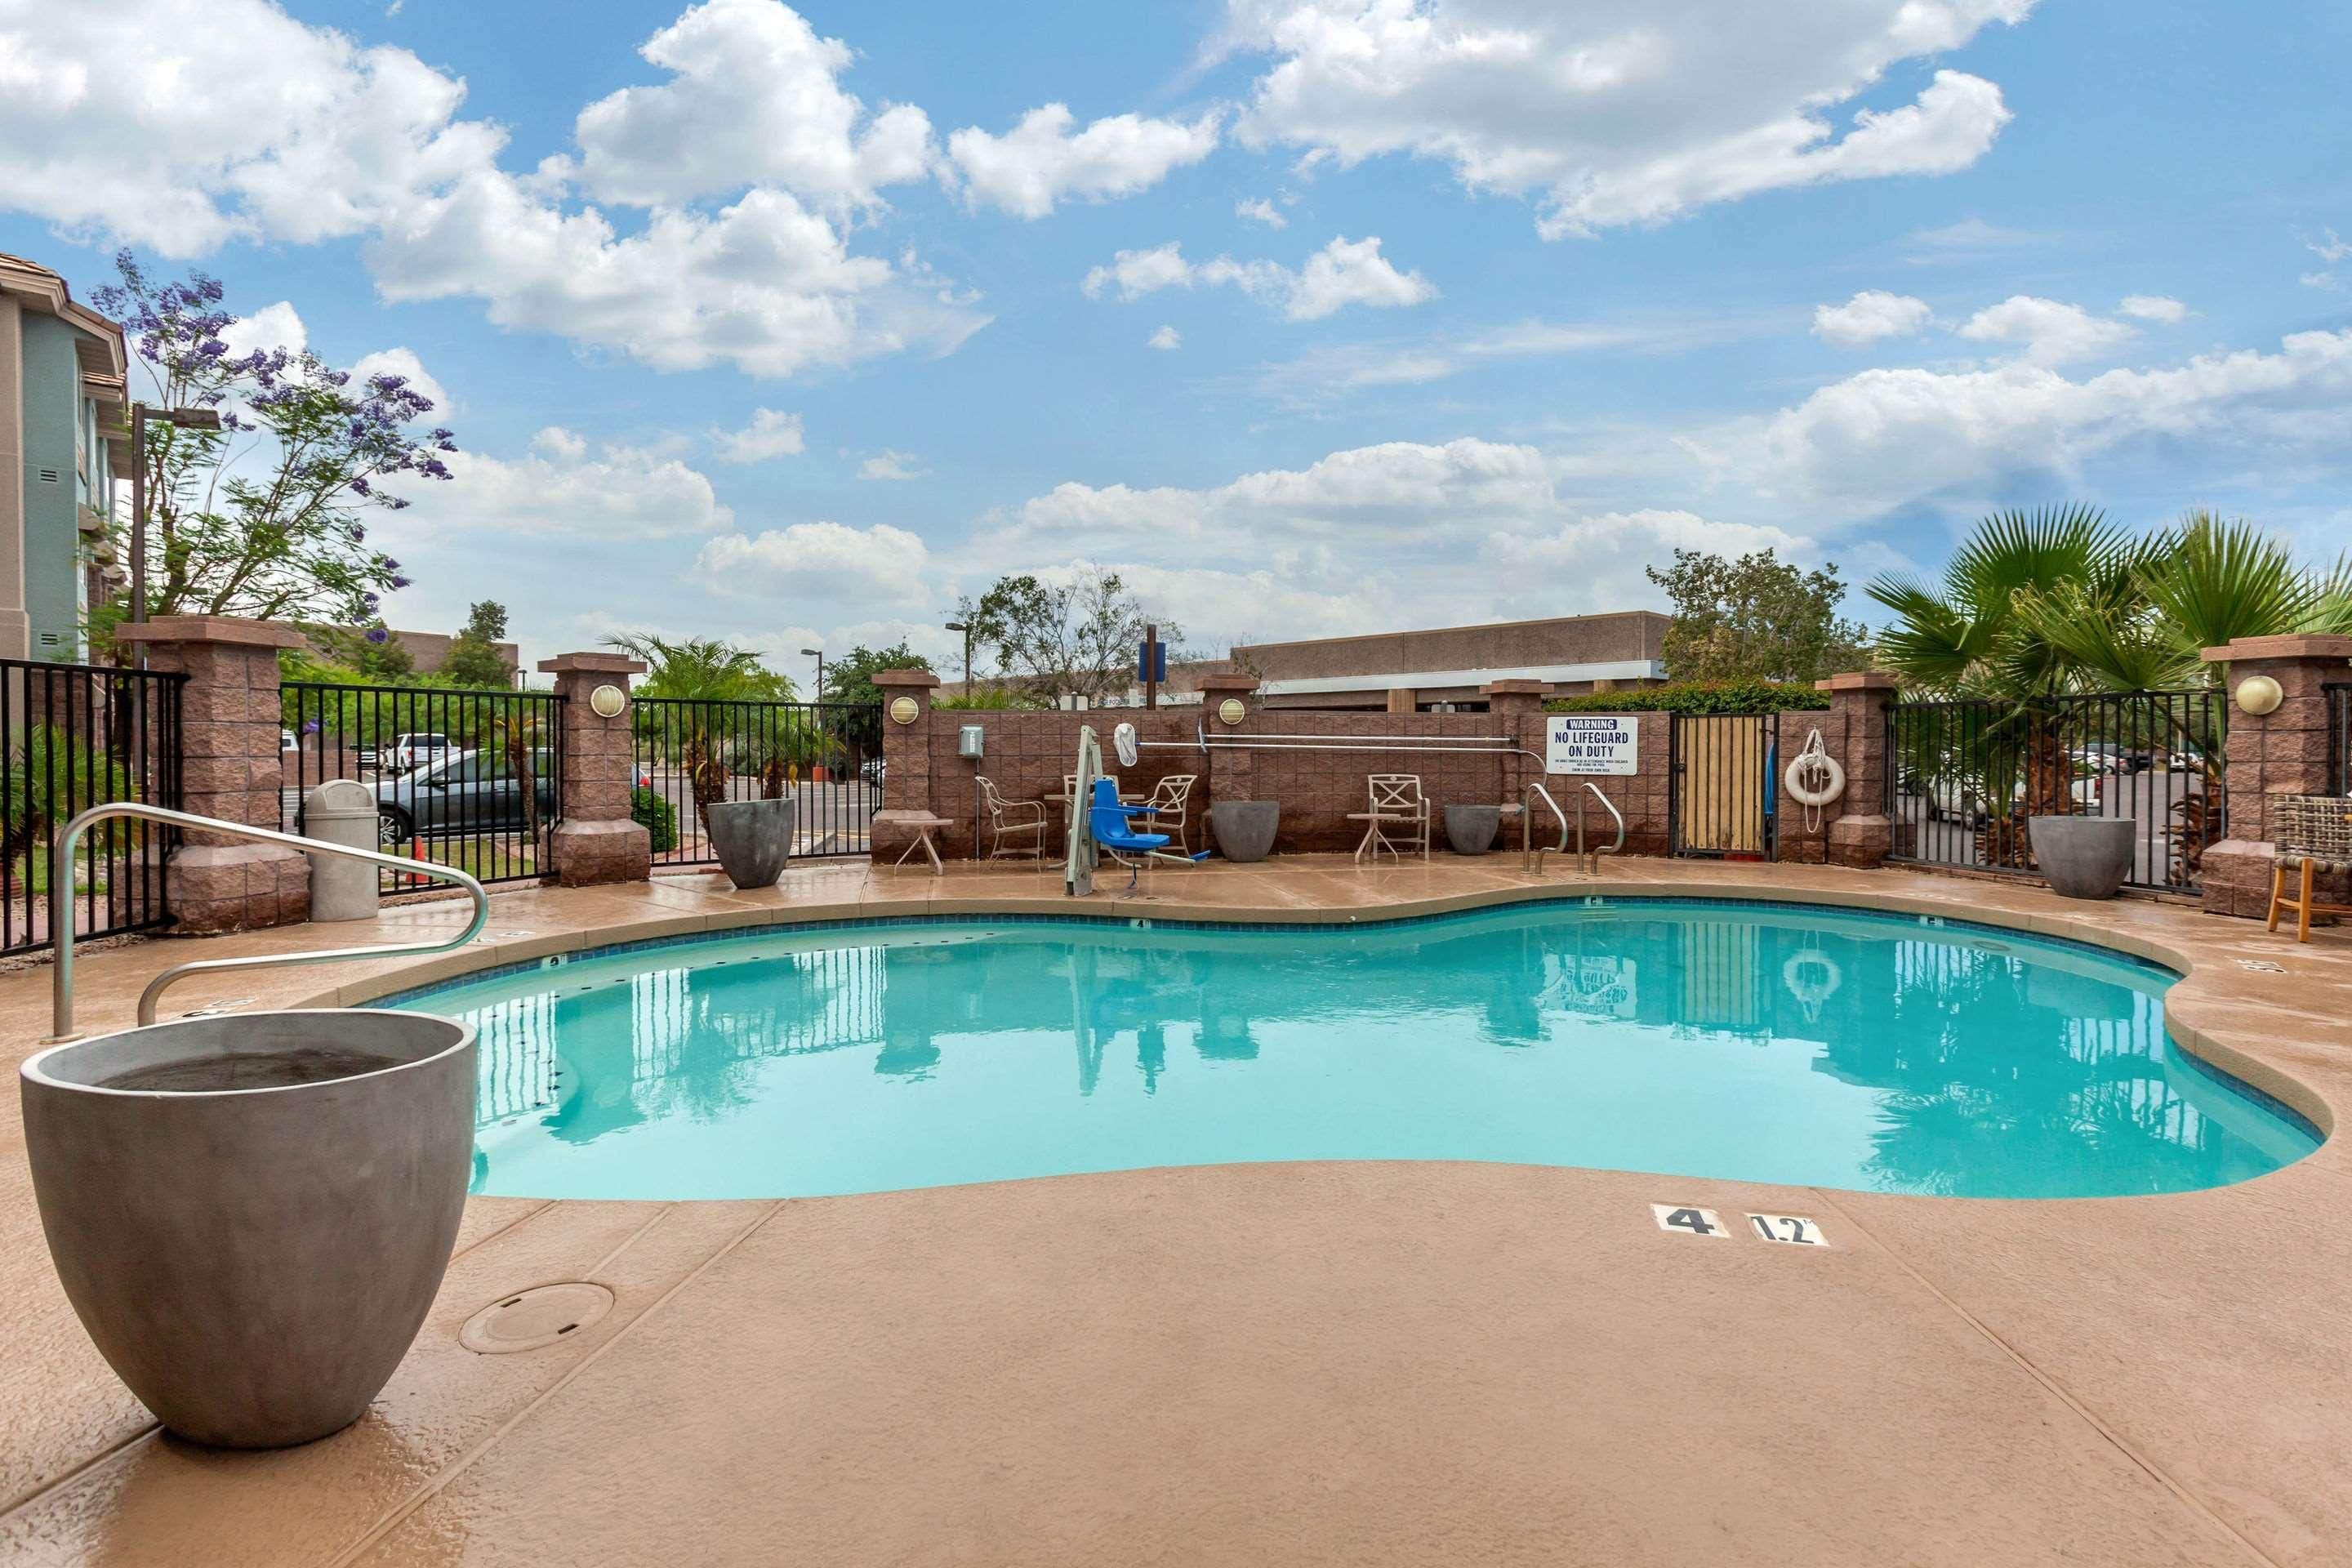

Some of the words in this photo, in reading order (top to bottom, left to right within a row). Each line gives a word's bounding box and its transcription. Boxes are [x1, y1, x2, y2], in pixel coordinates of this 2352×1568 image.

[1570, 719, 1614, 728] WARNING
[1555, 732, 1568, 743] NO
[1573, 732, 1628, 744] LIFEGUARD
[1568, 745, 1582, 757] ON
[1586, 746, 1615, 757] DUTY
[1666, 1209, 1715, 1234] 4
